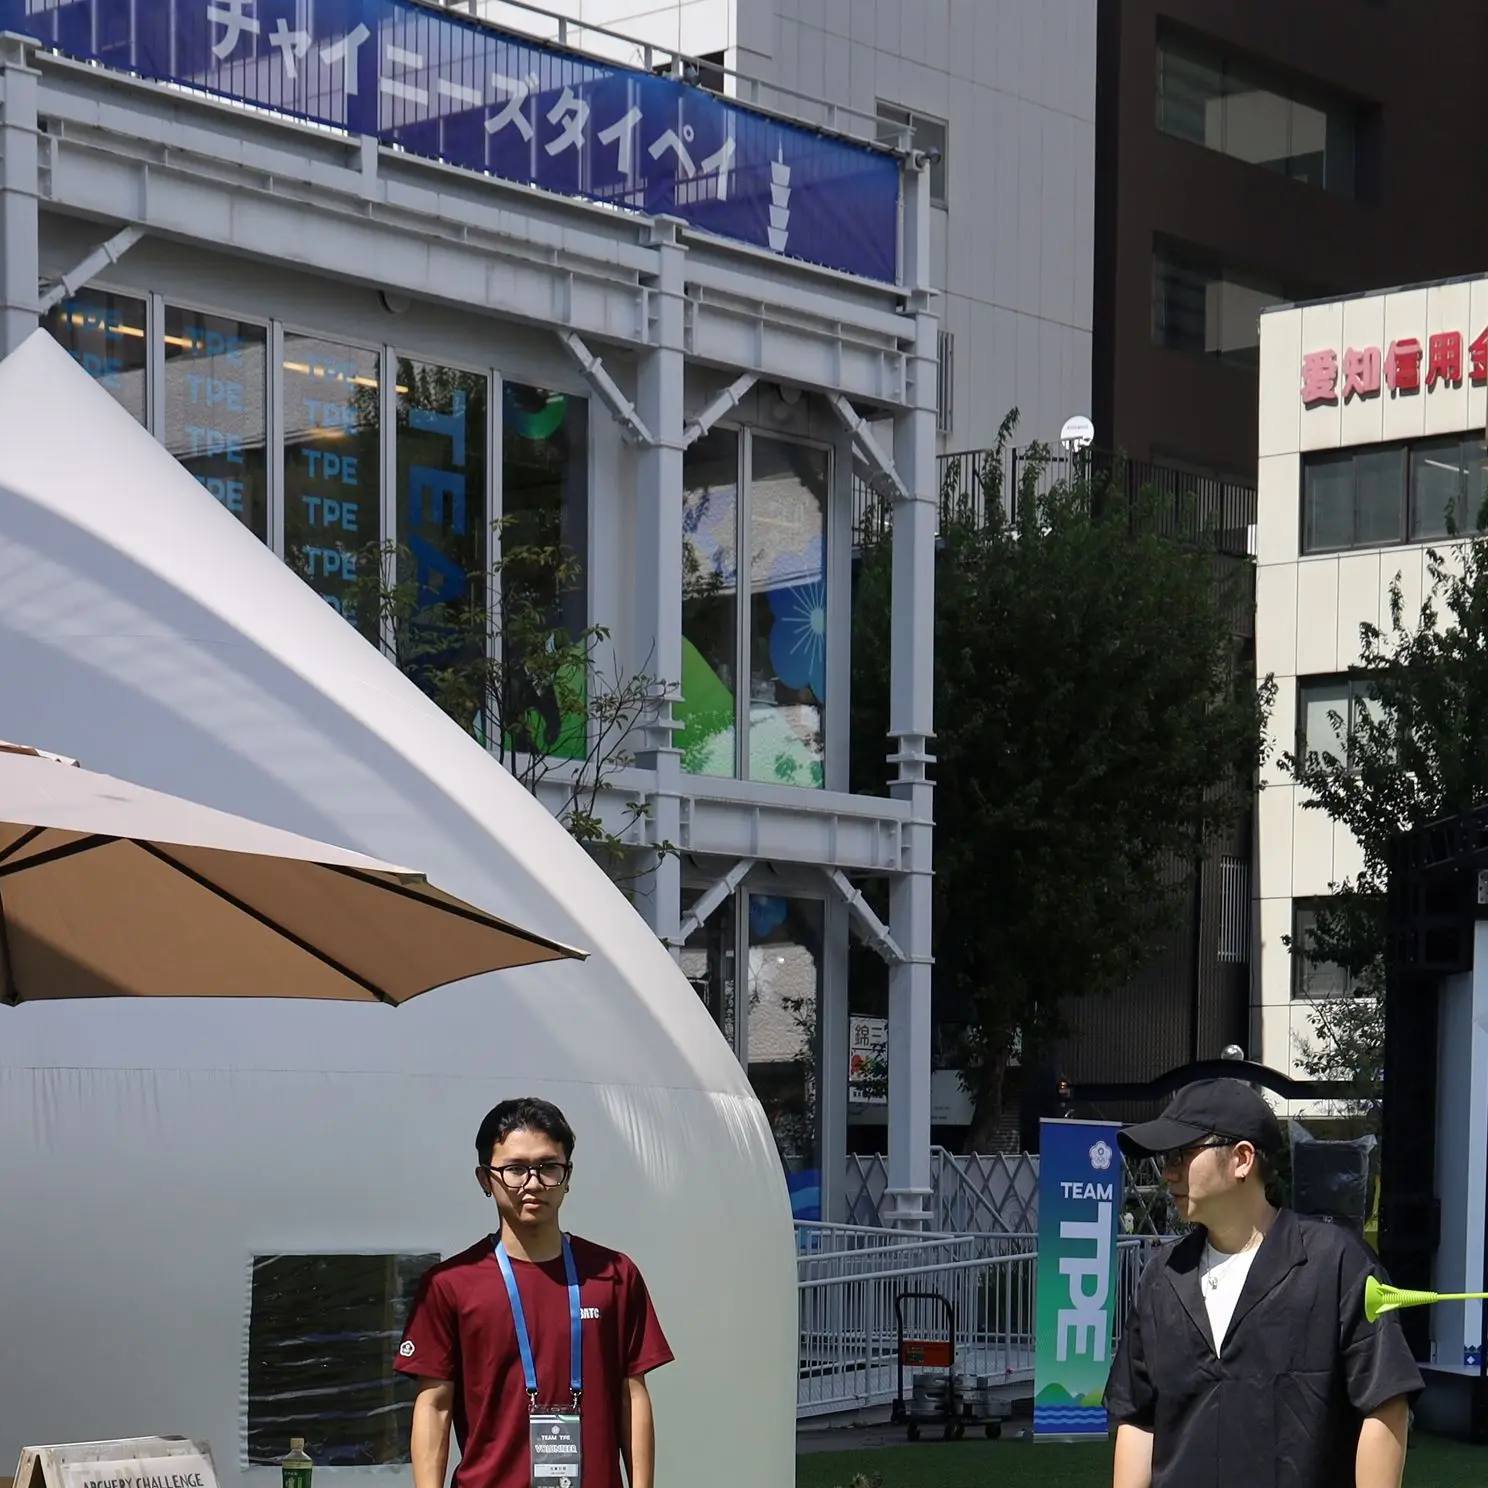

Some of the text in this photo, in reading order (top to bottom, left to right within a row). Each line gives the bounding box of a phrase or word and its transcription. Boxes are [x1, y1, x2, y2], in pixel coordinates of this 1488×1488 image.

[206, 0, 736, 200] チャイニーズタイペイ
[184, 325, 246, 366] TPE
[184, 373, 247, 414] TPE
[303, 398, 360, 437] TPE
[184, 424, 247, 465] TPE
[302, 447, 359, 487] TPE
[196, 474, 246, 513] PE
[302, 495, 359, 533] TPE
[302, 546, 359, 583] TPE
[1060, 1182, 1113, 1200] TEAM
[1056, 1201, 1113, 1362] TPE
